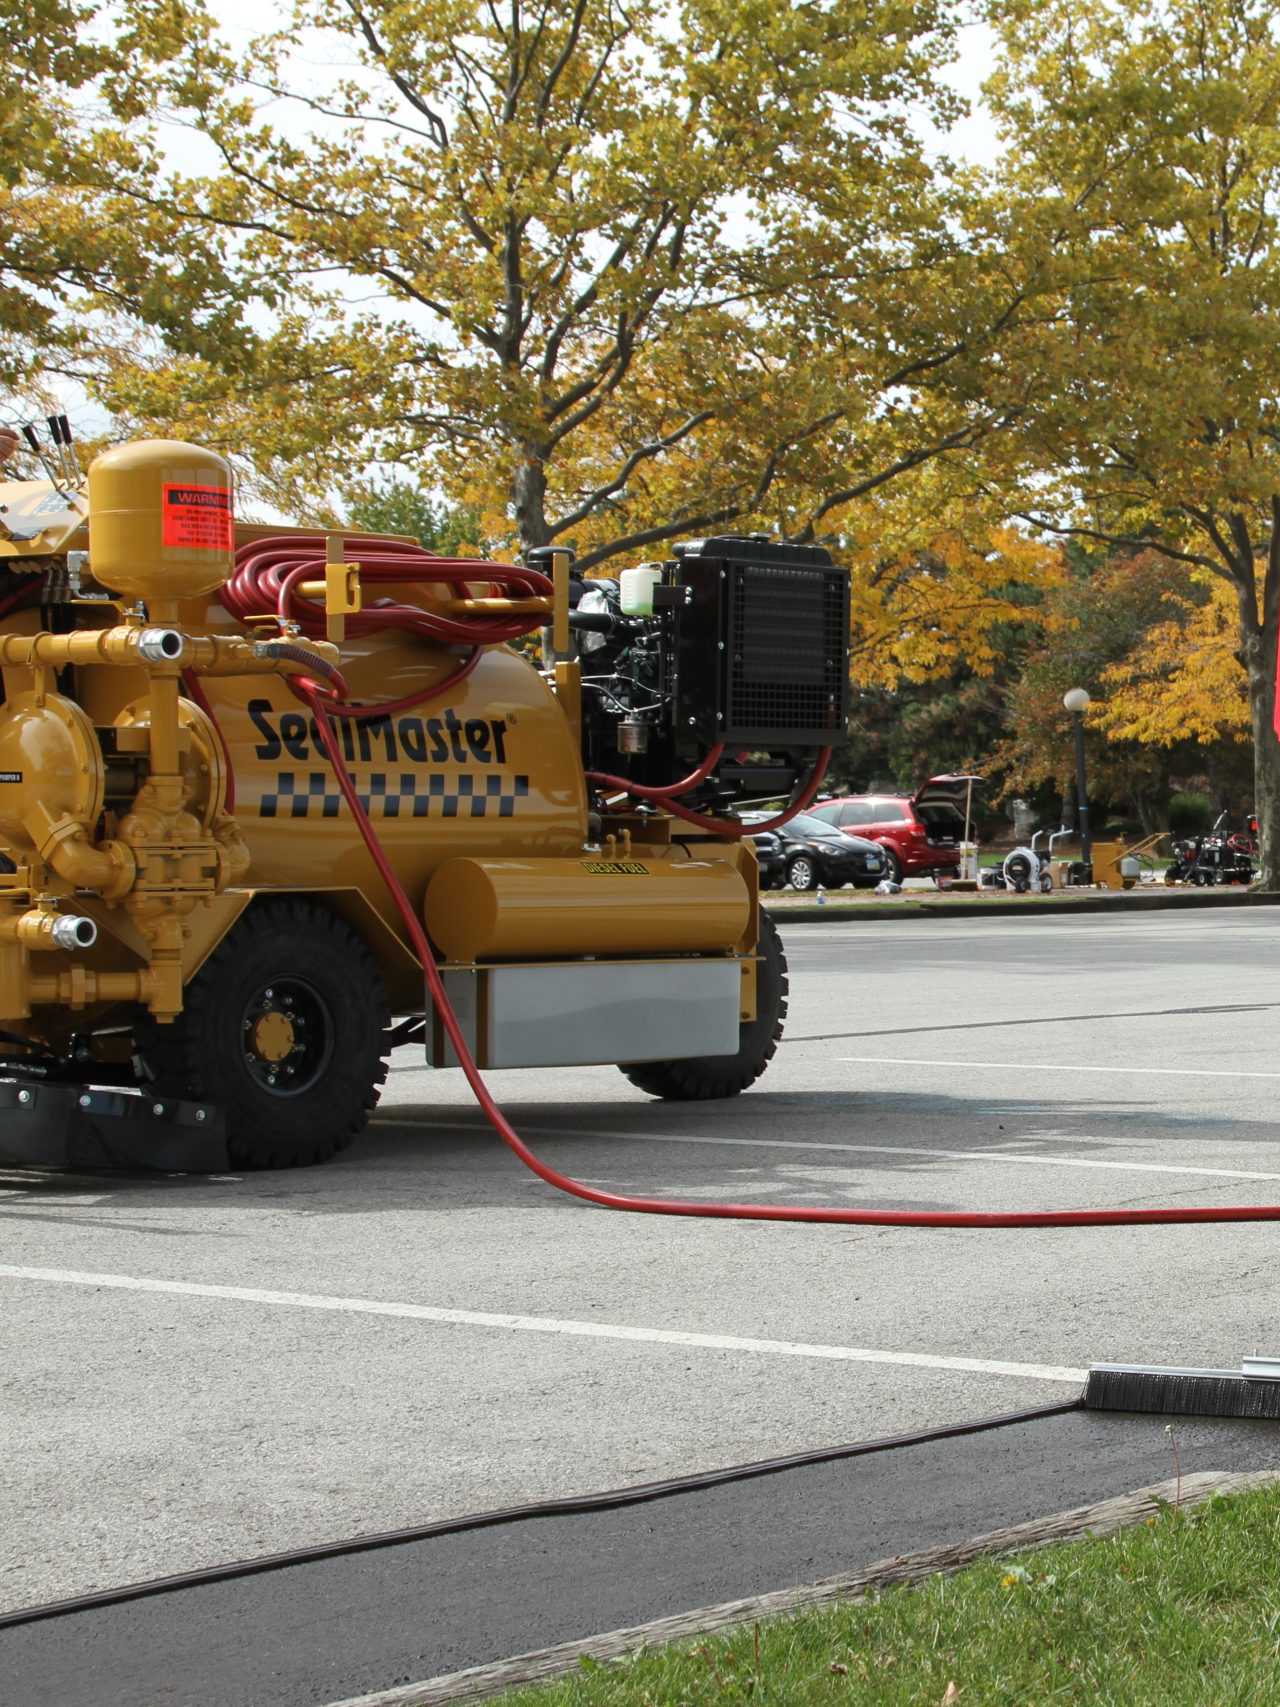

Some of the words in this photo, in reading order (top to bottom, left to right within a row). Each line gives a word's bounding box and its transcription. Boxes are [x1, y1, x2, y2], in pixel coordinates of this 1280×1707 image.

[177, 492, 230, 506] WARNIN
[582, 863, 622, 873] DIESEL
[618, 863, 648, 873] FUEL
